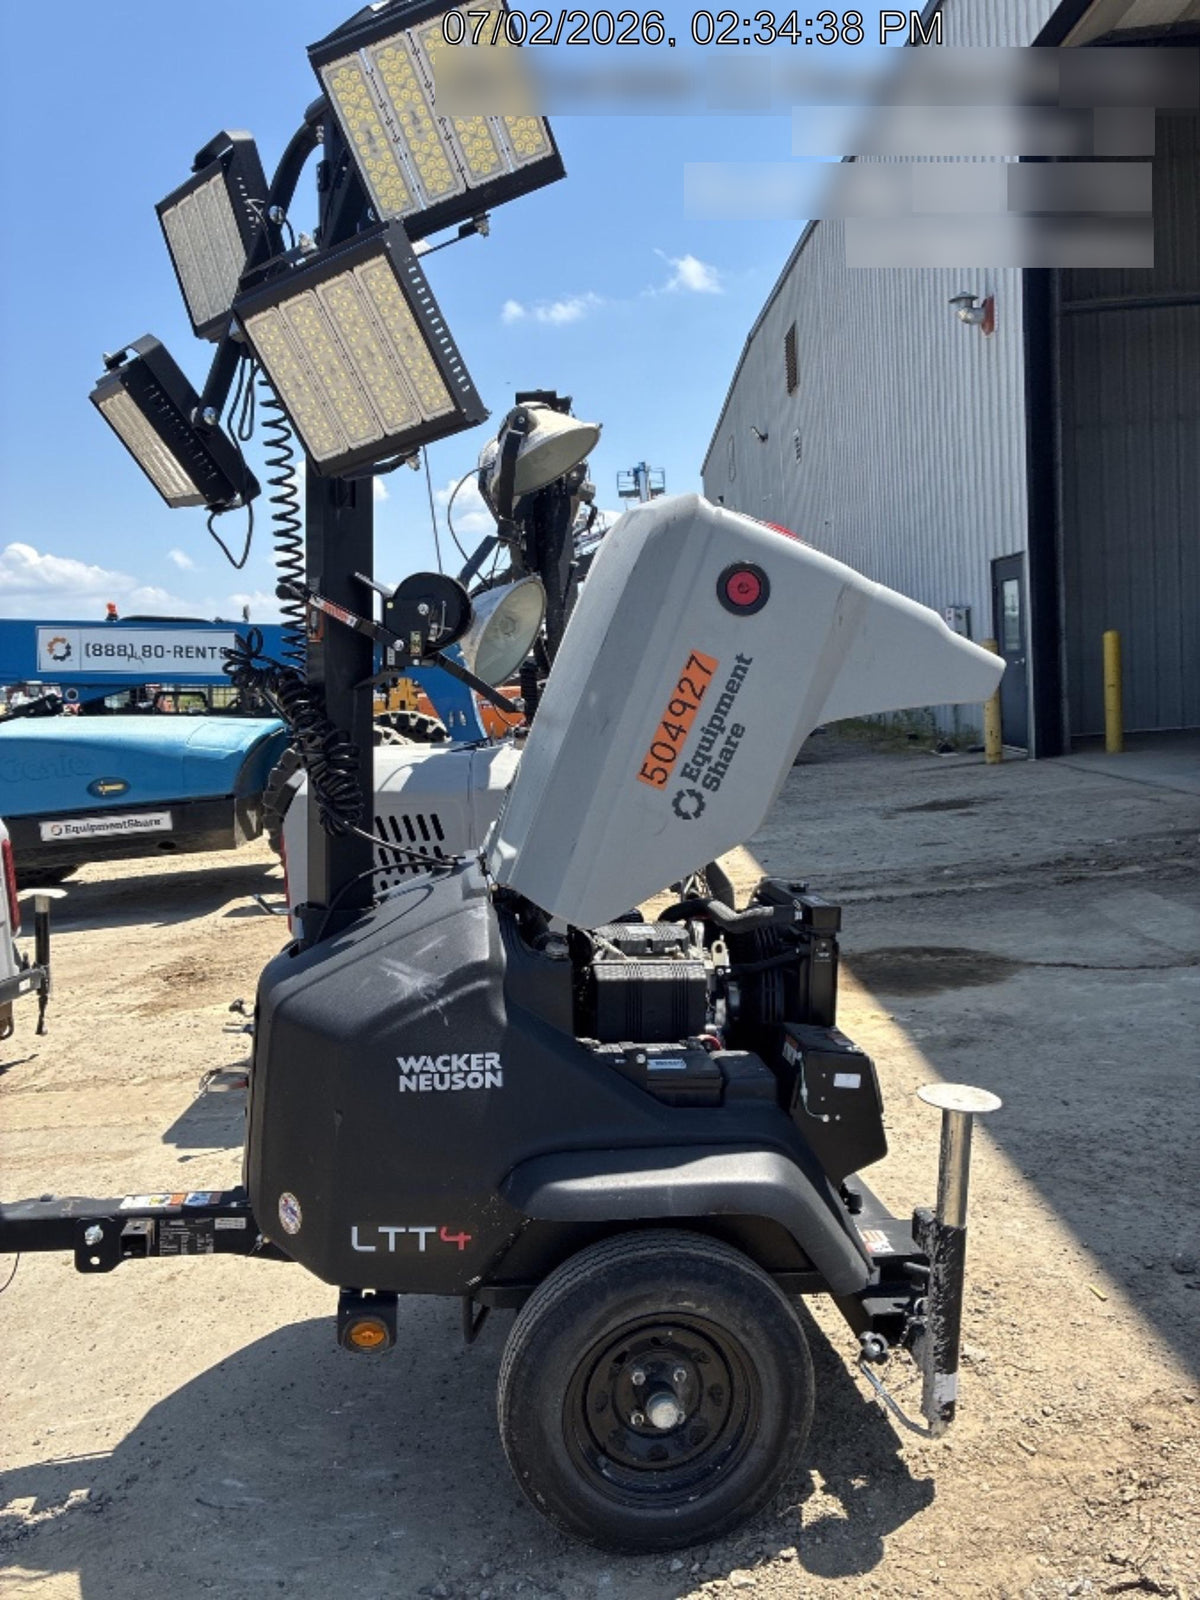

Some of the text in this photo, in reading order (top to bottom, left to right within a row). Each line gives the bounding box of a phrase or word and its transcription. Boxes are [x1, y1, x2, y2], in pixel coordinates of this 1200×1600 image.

[640, 653, 713, 785] 504927
[680, 652, 754, 784] Equipment
[702, 722, 746, 792] Share
[64, 818, 162, 835] EquipmentShare
[396, 1052, 503, 1074] WACKER
[398, 1070, 504, 1093] NEUSON
[350, 1225, 473, 1253] LTT4
